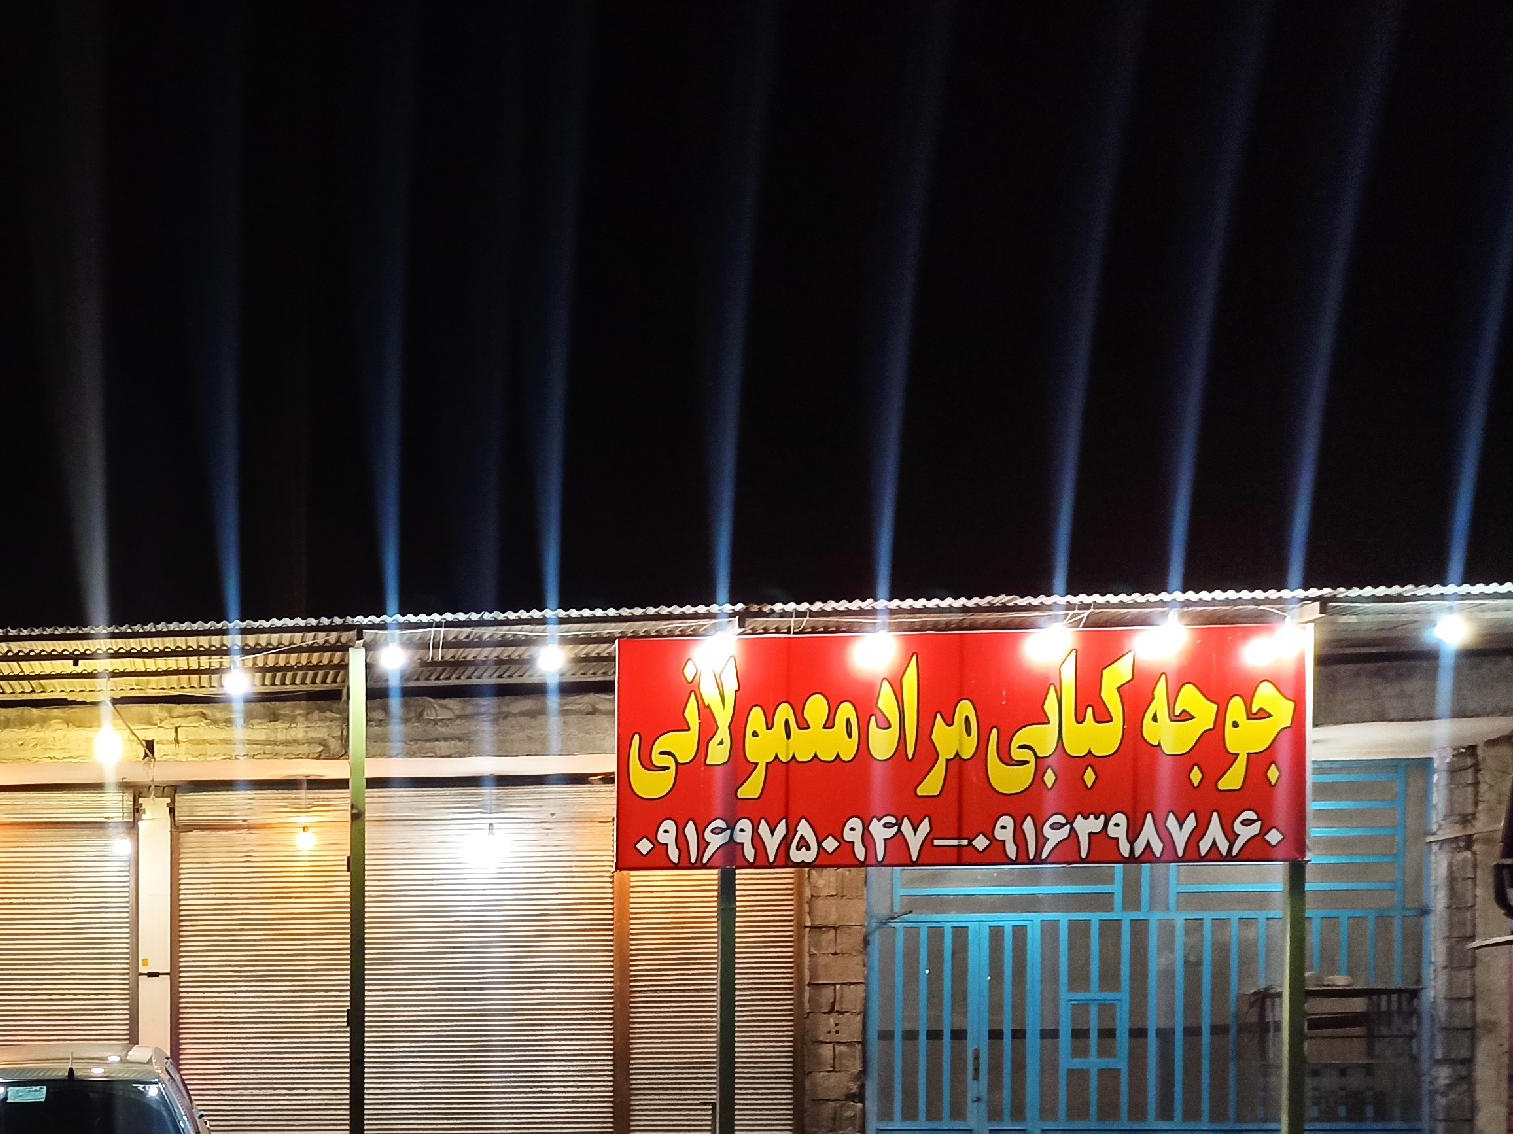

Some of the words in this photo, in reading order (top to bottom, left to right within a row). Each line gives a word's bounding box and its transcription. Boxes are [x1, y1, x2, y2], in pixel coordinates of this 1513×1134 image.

[868, 652, 979, 797] مراد
[986, 648, 1136, 795] کبابی
[1141, 671, 1296, 791] جوجه
